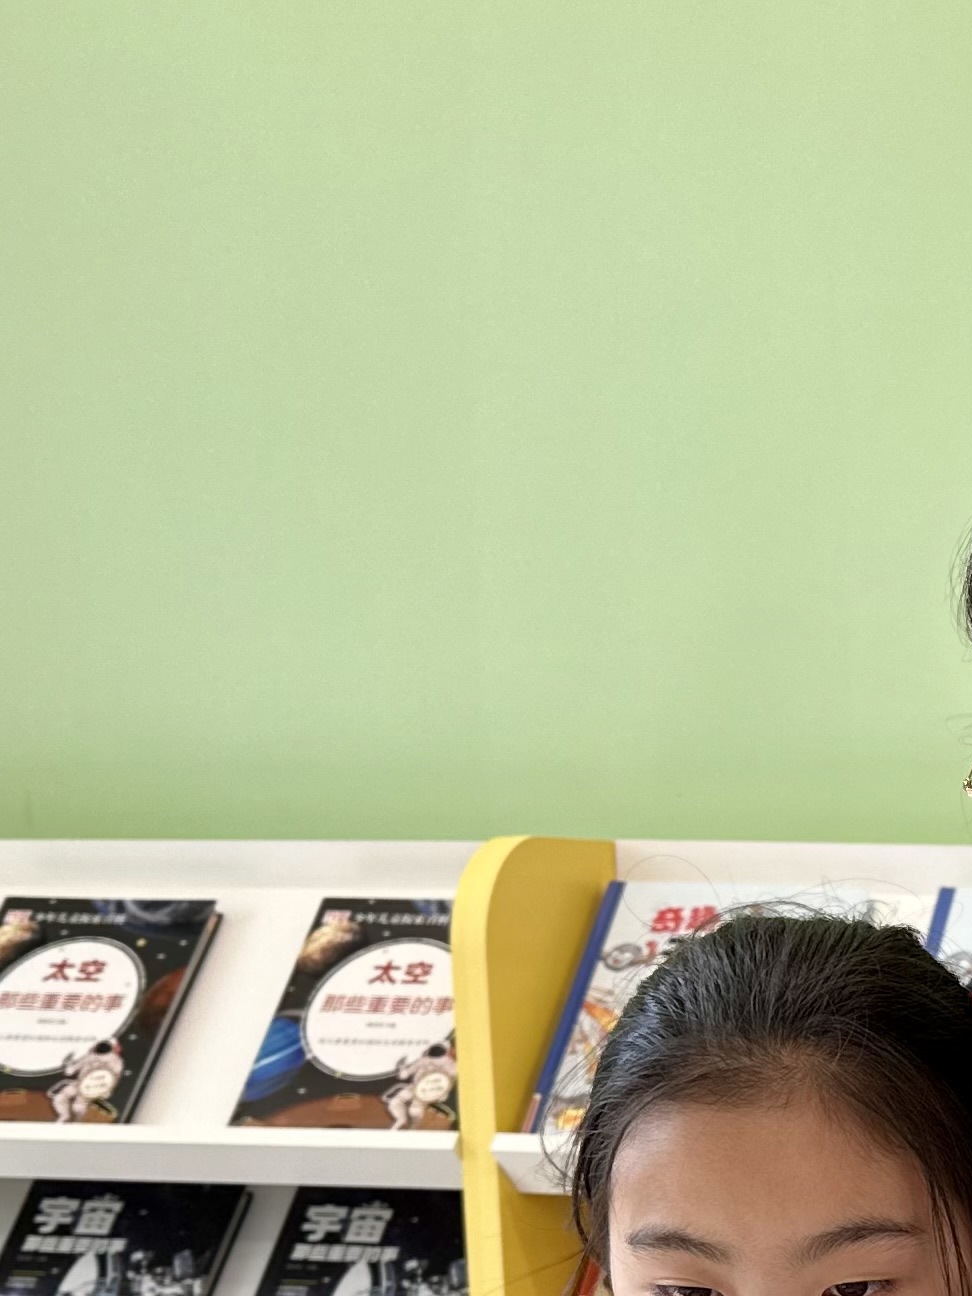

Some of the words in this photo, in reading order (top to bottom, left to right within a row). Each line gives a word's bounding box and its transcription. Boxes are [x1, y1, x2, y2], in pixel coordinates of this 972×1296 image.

[42, 958, 106, 984] 太空
[368, 960, 434, 985] 太空
[0, 992, 125, 1014] 那些重要的事
[319, 993, 456, 1015] 那些重要的事
[33, 1194, 125, 1236] 宇宙
[301, 1201, 394, 1244] 宇宙
